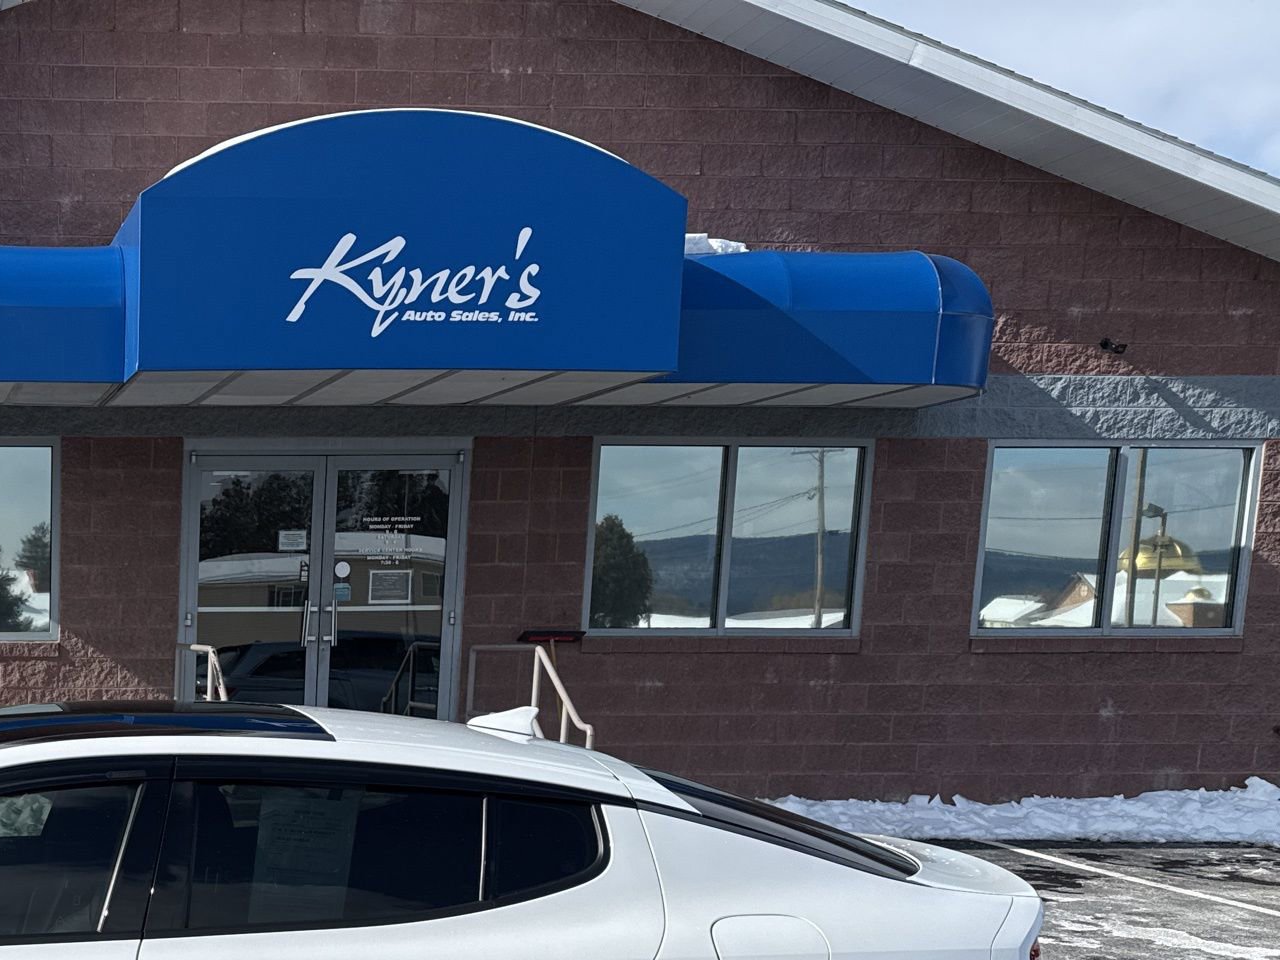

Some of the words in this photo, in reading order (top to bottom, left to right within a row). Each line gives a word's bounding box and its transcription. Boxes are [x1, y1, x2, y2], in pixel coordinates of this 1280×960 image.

[285, 226, 541, 338] Kyner's
[401, 310, 447, 322] Auto
[449, 310, 503, 324] Sales,
[507, 310, 539, 322] Inc.
